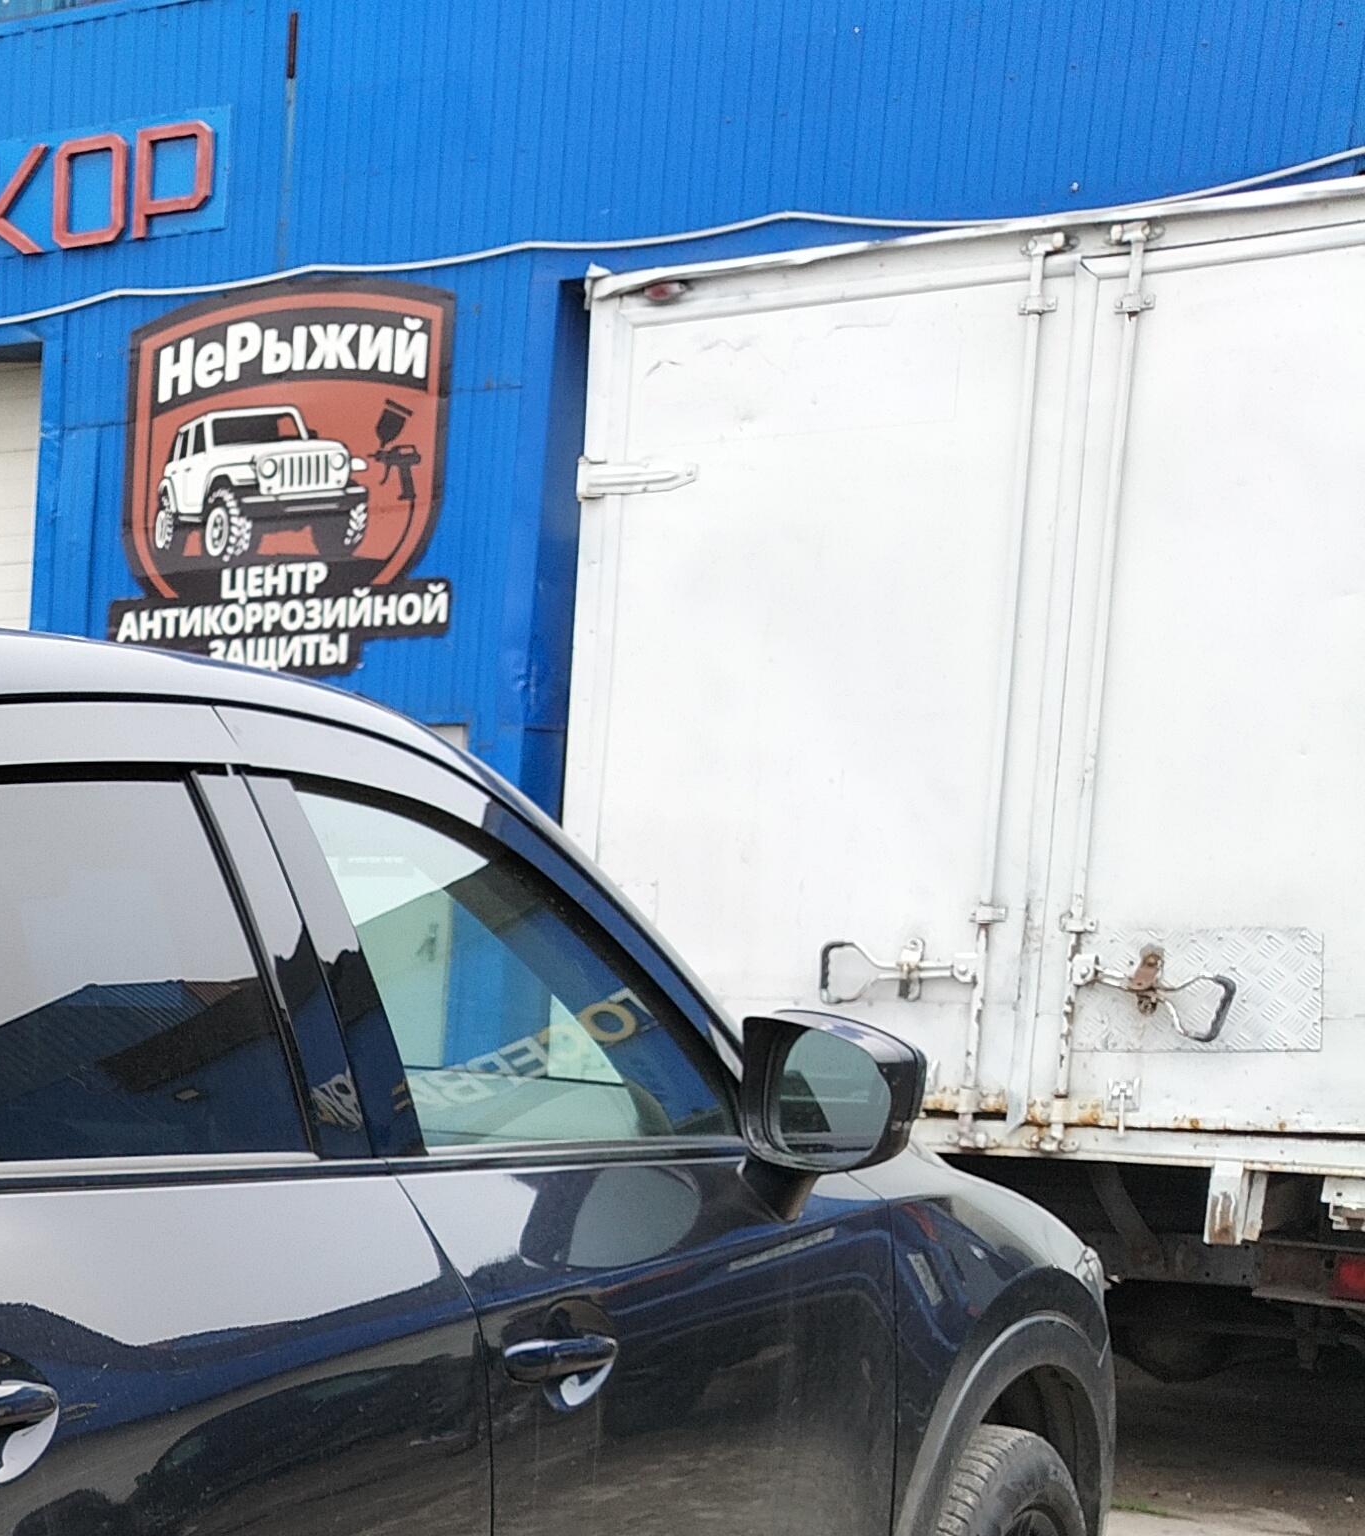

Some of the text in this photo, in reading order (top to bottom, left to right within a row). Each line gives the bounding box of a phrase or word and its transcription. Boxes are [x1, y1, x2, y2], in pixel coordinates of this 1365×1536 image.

[220, 561, 329, 604] ЦЕНТР
[116, 582, 449, 643] АНТИКОРРОЗИЙНОЙ
[208, 632, 350, 671] ЗАЩИТЫ
